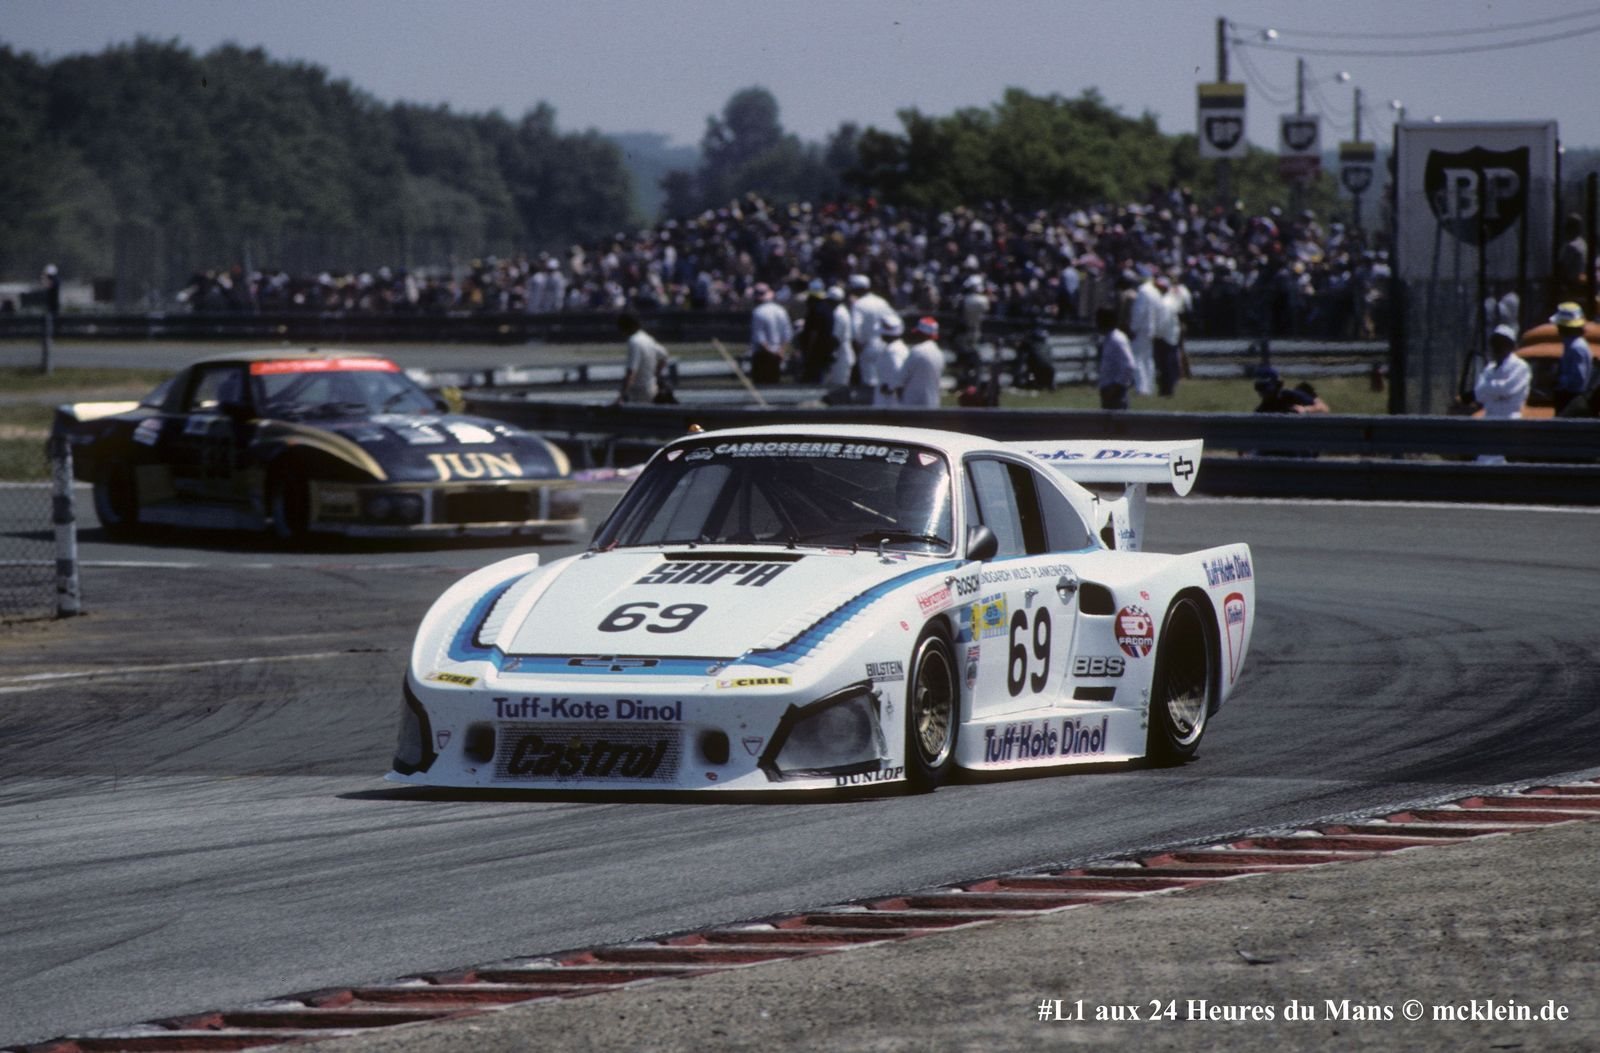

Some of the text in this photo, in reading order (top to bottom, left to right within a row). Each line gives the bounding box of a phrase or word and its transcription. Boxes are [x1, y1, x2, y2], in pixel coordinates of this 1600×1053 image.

[1440, 166, 1520, 220] BP
[714, 442, 843, 455] CARROSSERIE
[844, 445, 889, 456] 2000
[427, 453, 524, 482] JUN
[634, 562, 793, 587] SAPA
[956, 574, 981, 597] BOSCH
[597, 601, 709, 634] 69
[1008, 605, 1052, 698] 69
[1118, 636, 1154, 646] FACOM
[865, 660, 904, 677] BILSTEIN
[1073, 655, 1126, 678] BBS
[736, 676, 792, 687] CIBIE
[493, 697, 683, 722] Tuff-Kote Dinol
[984, 714, 1110, 764] Tuff-Kote Dinol
[507, 735, 670, 779] Castrol
[835, 766, 904, 787] DUNLOP
